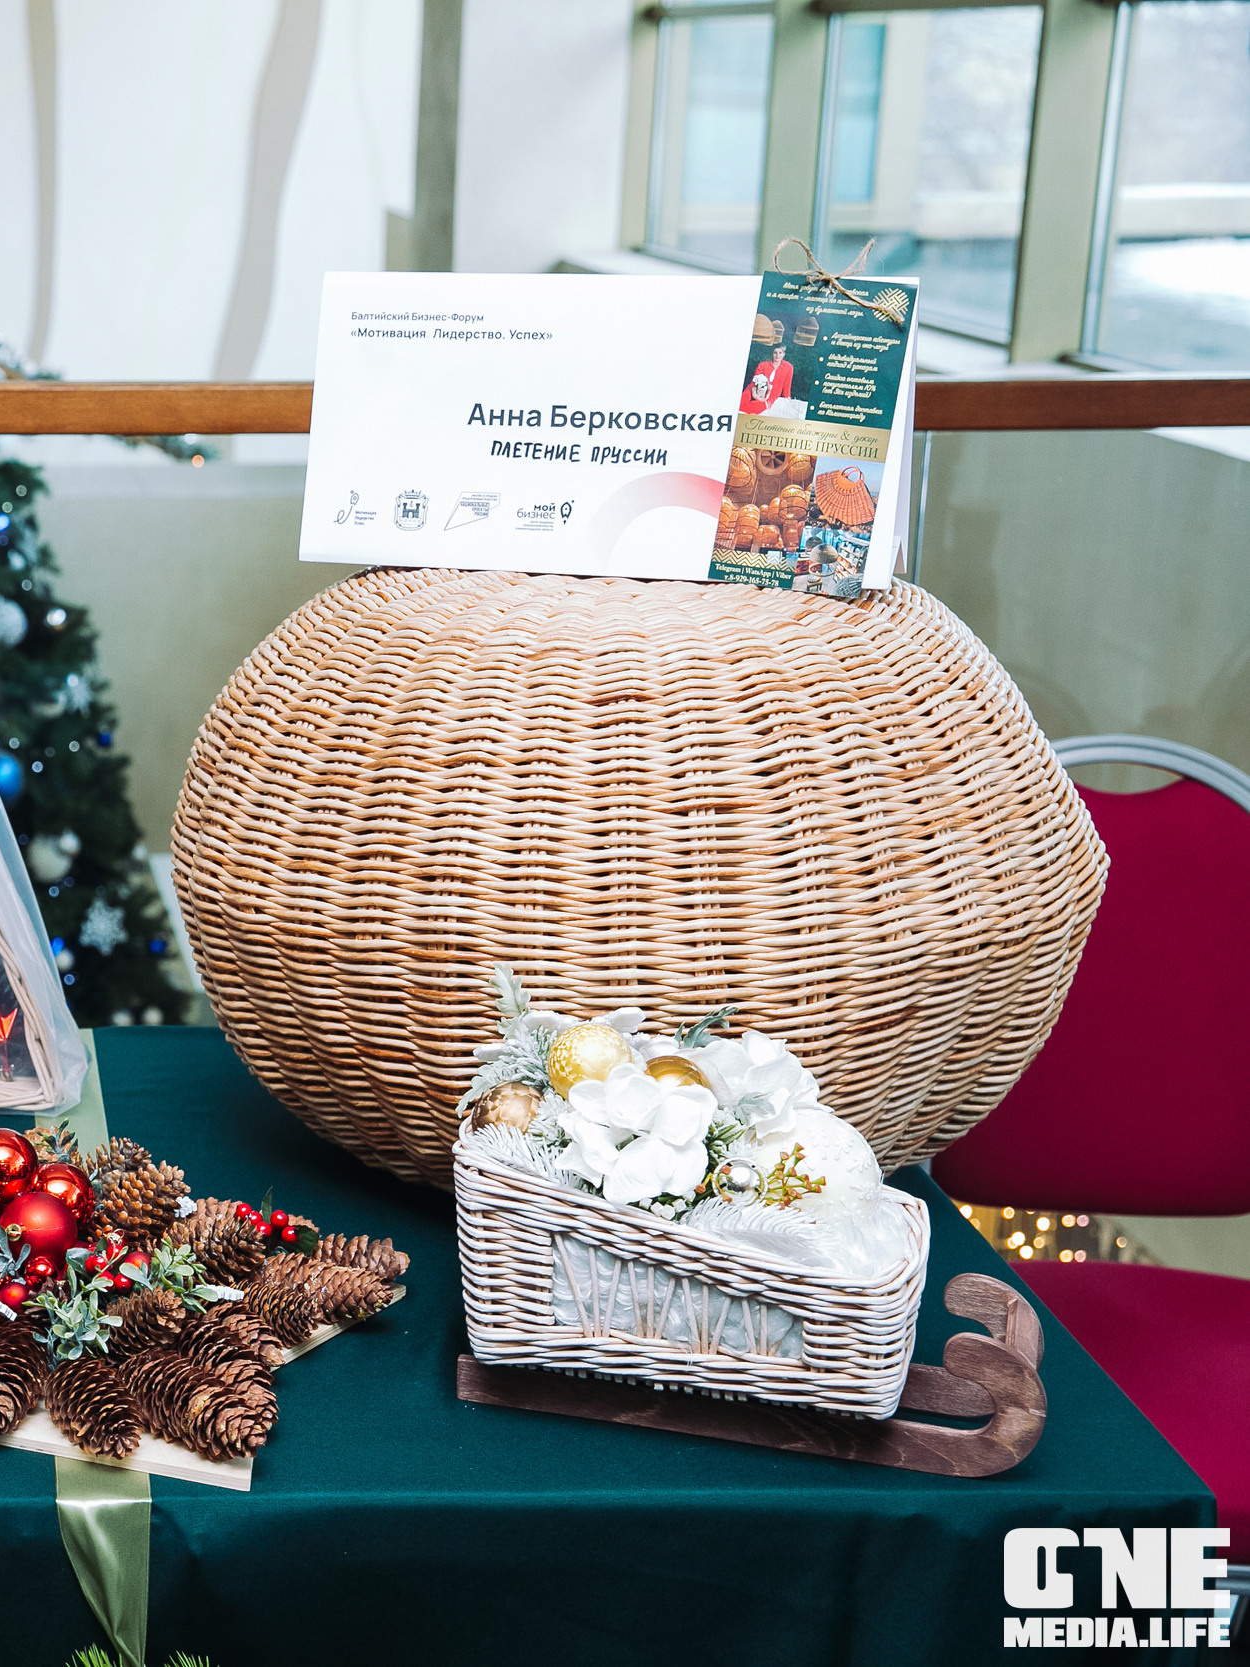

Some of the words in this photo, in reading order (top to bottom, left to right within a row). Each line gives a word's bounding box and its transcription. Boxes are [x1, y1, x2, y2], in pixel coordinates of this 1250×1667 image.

[351, 311, 410, 322] Балтийский
[411, 312, 485, 324] Бизнес-Форум
[433, 328, 506, 341] Лидерство.
[509, 329, 553, 341] Успех»
[466, 402, 542, 428] Анна
[550, 404, 733, 436] Берковская
[796, 424, 839, 441] абажуры
[840, 430, 851, 441] &
[490, 440, 581, 463] ПЛЕТЕНИЕ
[590, 446, 668, 466] ПРУССИИ
[740, 432, 813, 451] ПЛЕТЕНИЕ
[815, 441, 879, 459] ПРУССИИ
[516, 508, 556, 520] бизнес
[533, 502, 556, 512] мой
[715, 564, 741, 573] Telegram
[776, 571, 792, 580] Viber
